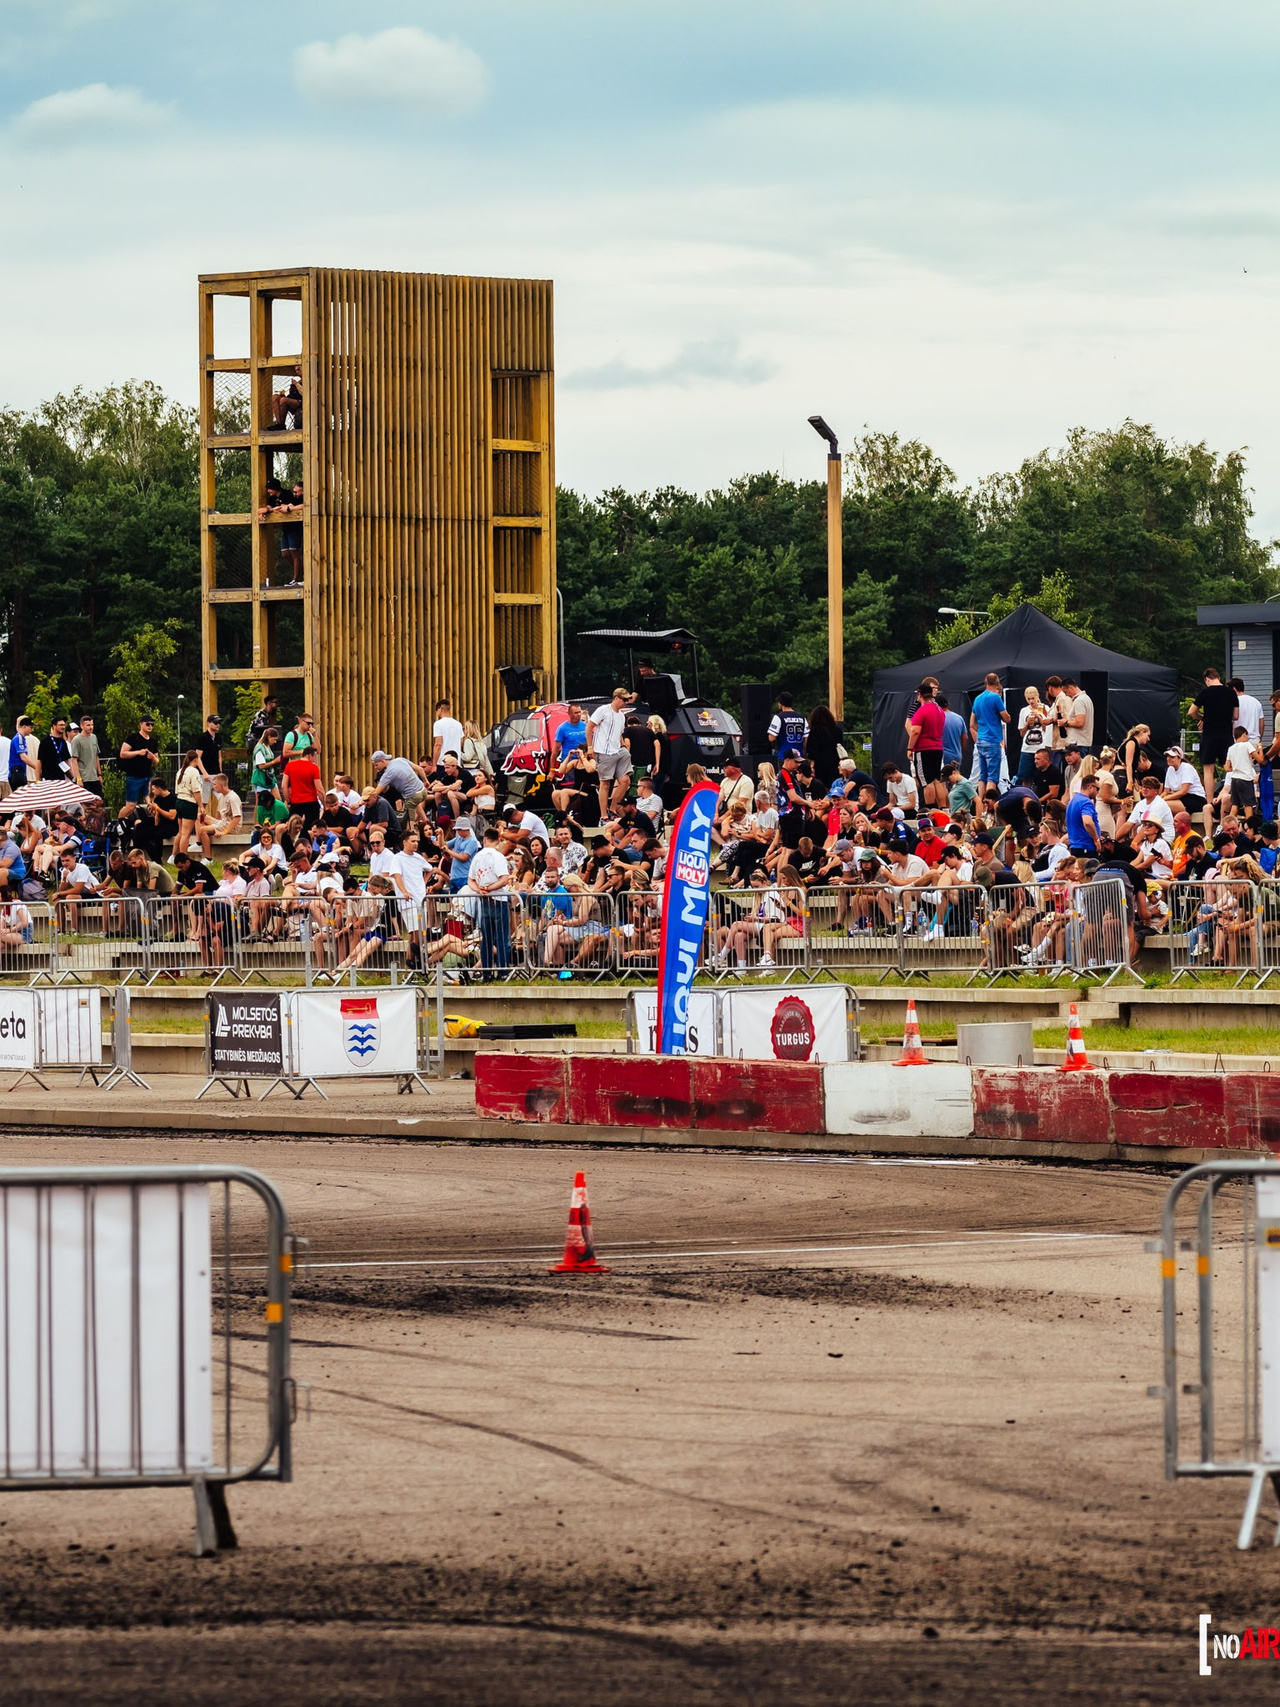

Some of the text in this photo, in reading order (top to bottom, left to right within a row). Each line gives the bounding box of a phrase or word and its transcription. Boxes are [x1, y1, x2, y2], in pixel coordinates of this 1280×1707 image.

[785, 723, 804, 744] 96
[678, 851, 706, 871] LIQUI
[677, 864, 705, 884] MOLY
[232, 1006, 278, 1022] MOLSETOS
[0, 1011, 26, 1039] eta
[232, 1024, 273, 1039] PREKYBA
[776, 1032, 810, 1046] TURGUS
[214, 1048, 281, 1063] STATYBINĖS MEDŽIAGOS
